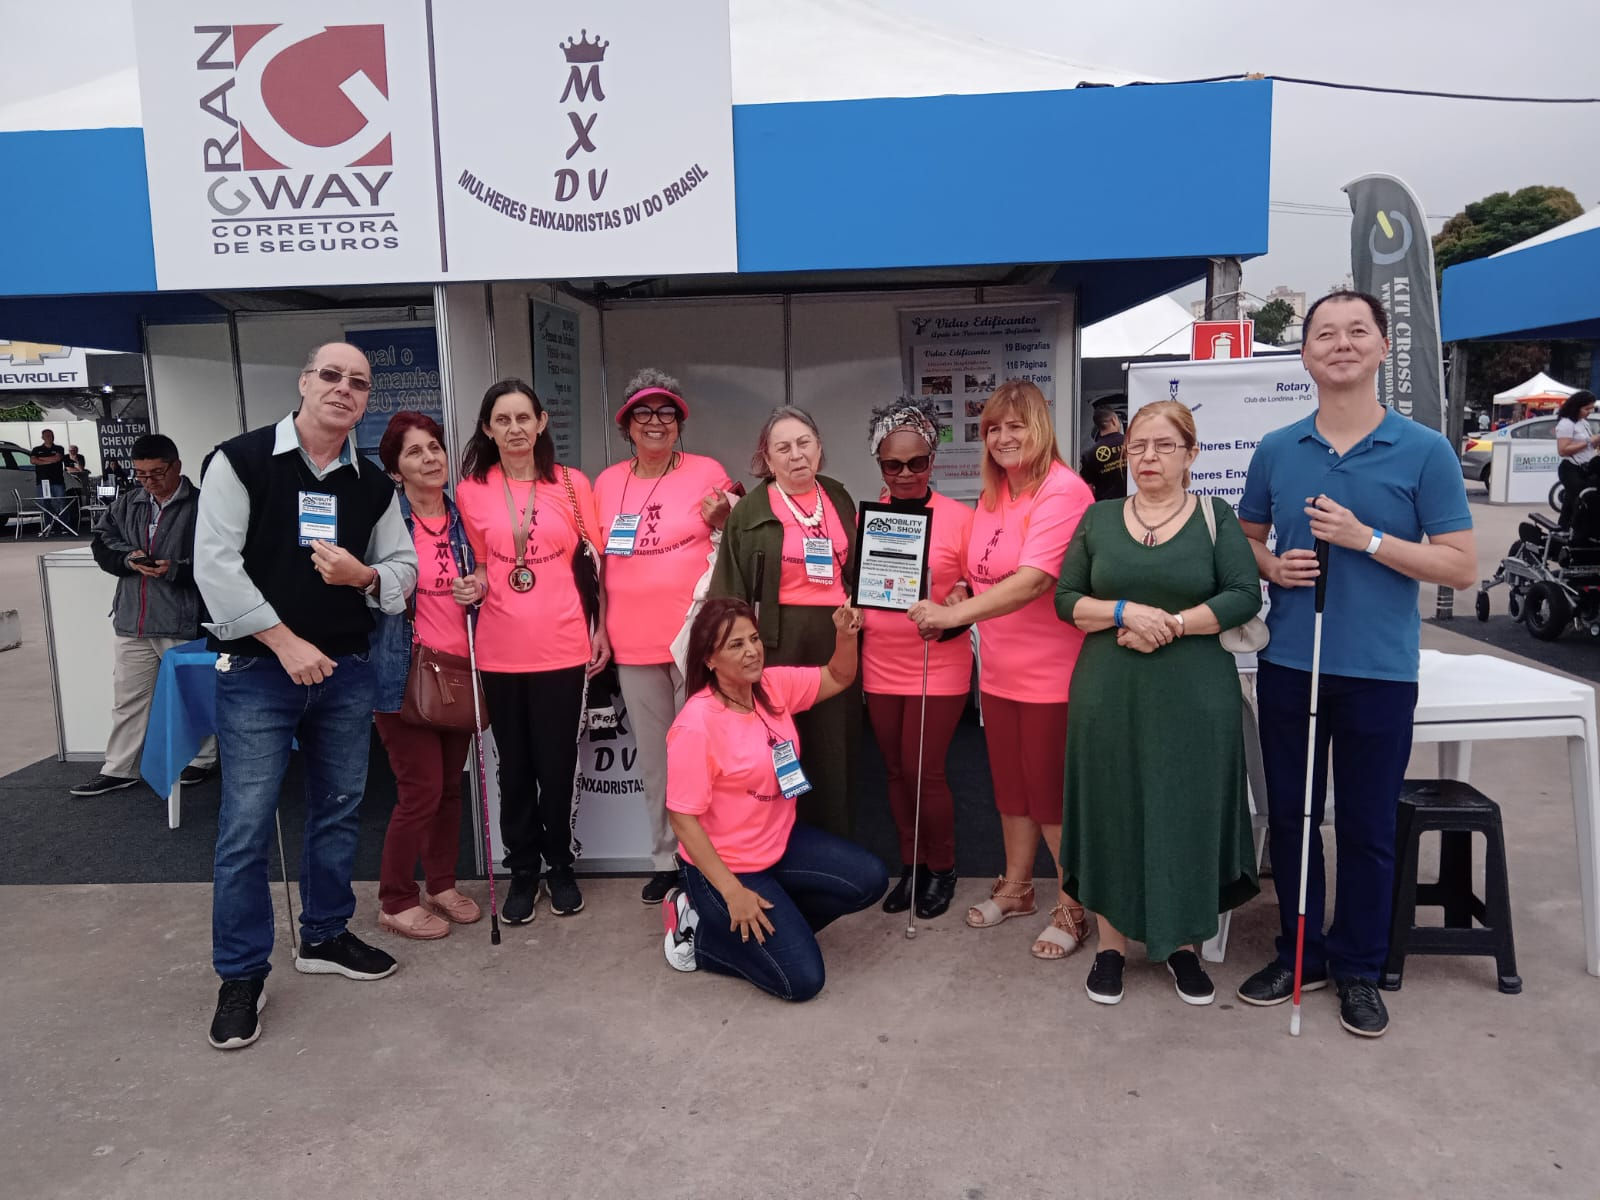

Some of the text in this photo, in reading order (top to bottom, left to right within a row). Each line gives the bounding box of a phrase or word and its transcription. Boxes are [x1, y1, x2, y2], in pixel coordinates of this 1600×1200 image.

[559, 64, 606, 103] M
[565, 111, 598, 160] X
[458, 163, 709, 232] MULHERES ENXADRISTAS DV DO BRASIL
[212, 220, 398, 238] CORRETORA
[214, 237, 399, 255] DE SEGUROS
[935, 315, 1037, 329] Vidas Edificantes
[1015, 341, 1050, 352] Biografias
[1393, 276, 1414, 420] KIT CROSS D
[365, 345, 396, 366] ual
[1020, 360, 1048, 370] Páginas
[0, 372, 78, 384] EVROLET
[1276, 382, 1311, 393] Rotary
[1244, 396, 1258, 404] Club
[101, 424, 146, 434] AQUI TEM
[1197, 441, 1231, 451] lheres
[103, 448, 124, 458] PRA
[1191, 471, 1222, 481] heres
[645, 511, 661, 522] M
[885, 517, 922, 526] MOBILITY
[645, 522, 657, 536] X
[897, 526, 921, 534] SHOW
[435, 549, 450, 560] M
[438, 562, 449, 576] X
[580, 776, 644, 795] NXADRISTA
